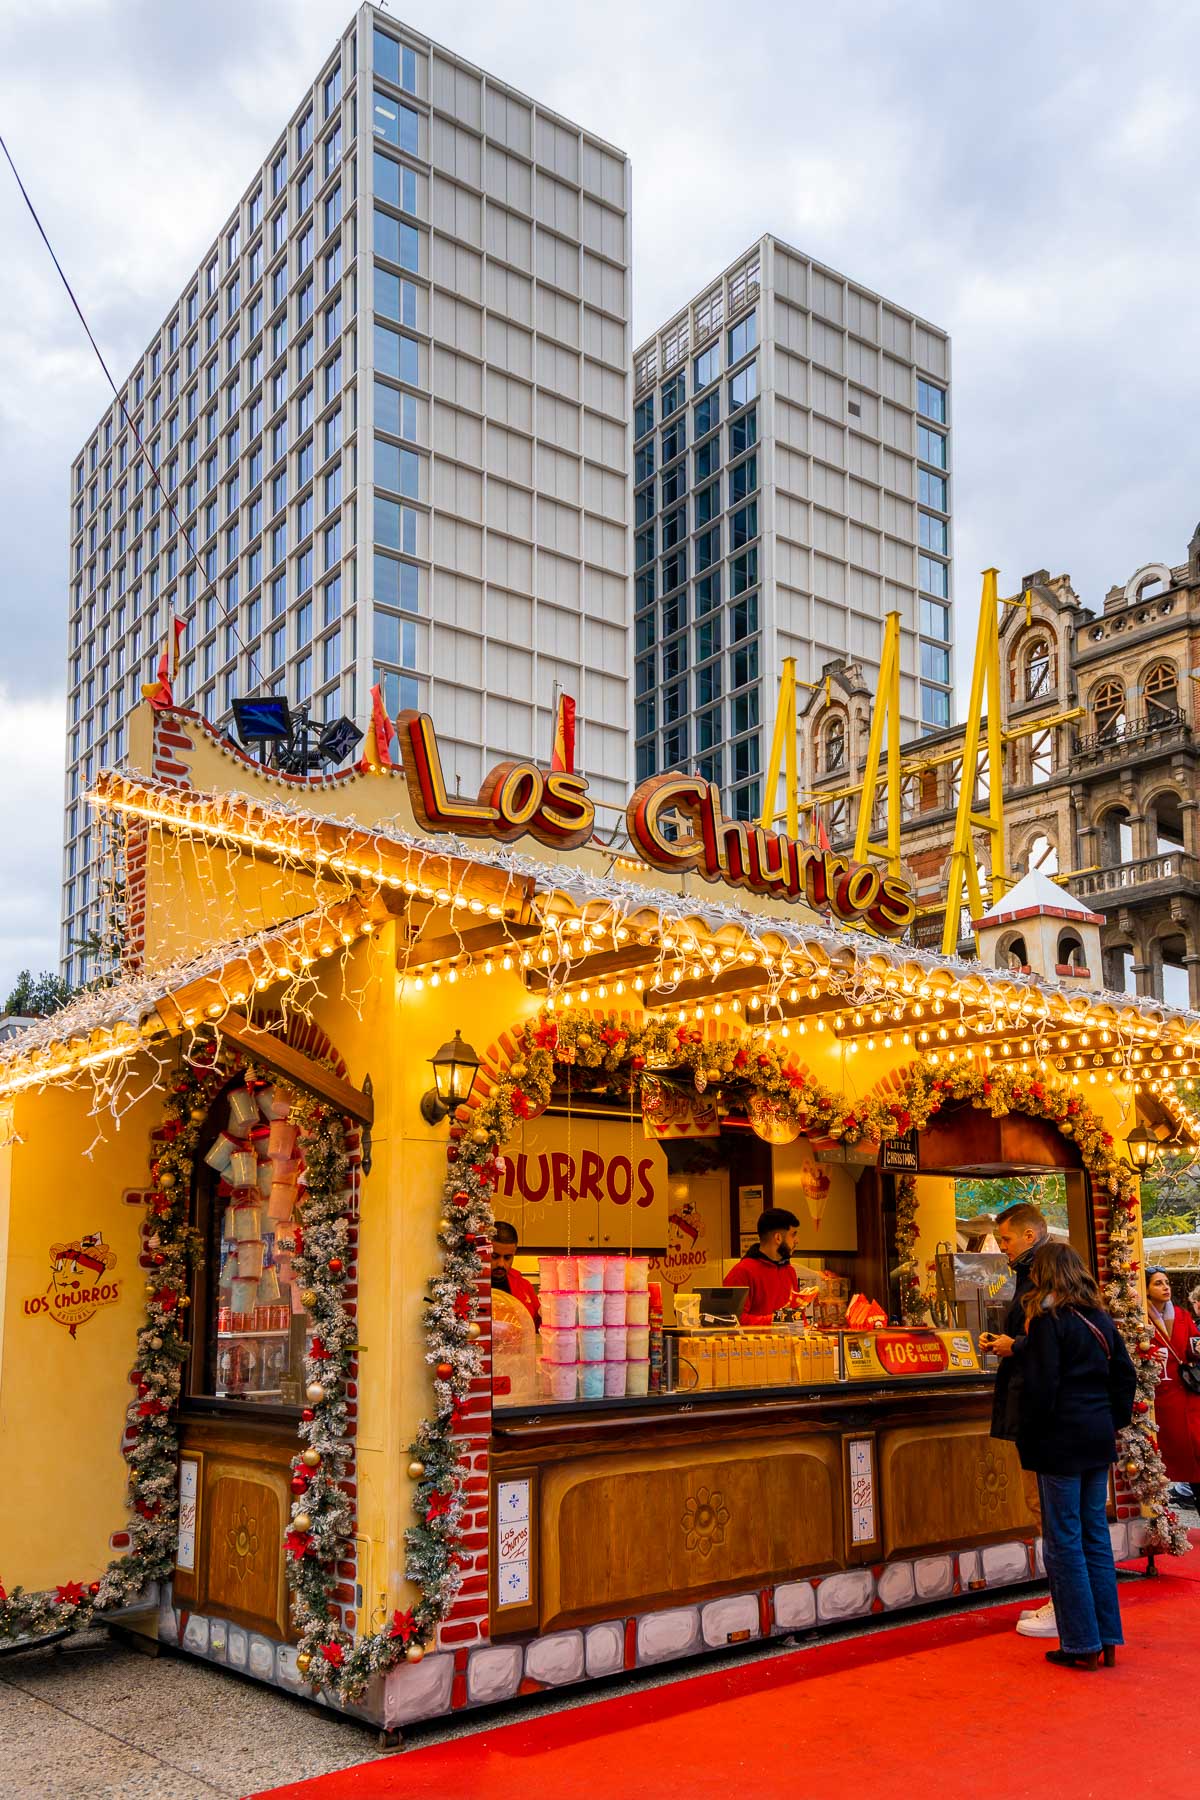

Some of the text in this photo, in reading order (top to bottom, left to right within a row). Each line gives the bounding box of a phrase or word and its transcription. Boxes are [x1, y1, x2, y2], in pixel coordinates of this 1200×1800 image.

[890, 1140, 911, 1150] LITTLE
[887, 1151, 916, 1166] CHRISTMAS
[24, 1296, 50, 1315] LOS
[885, 1342, 918, 1364] 10€
[853, 1478, 866, 1493] Los
[500, 1528, 515, 1544] Los
[501, 1527, 528, 1557] Churros
